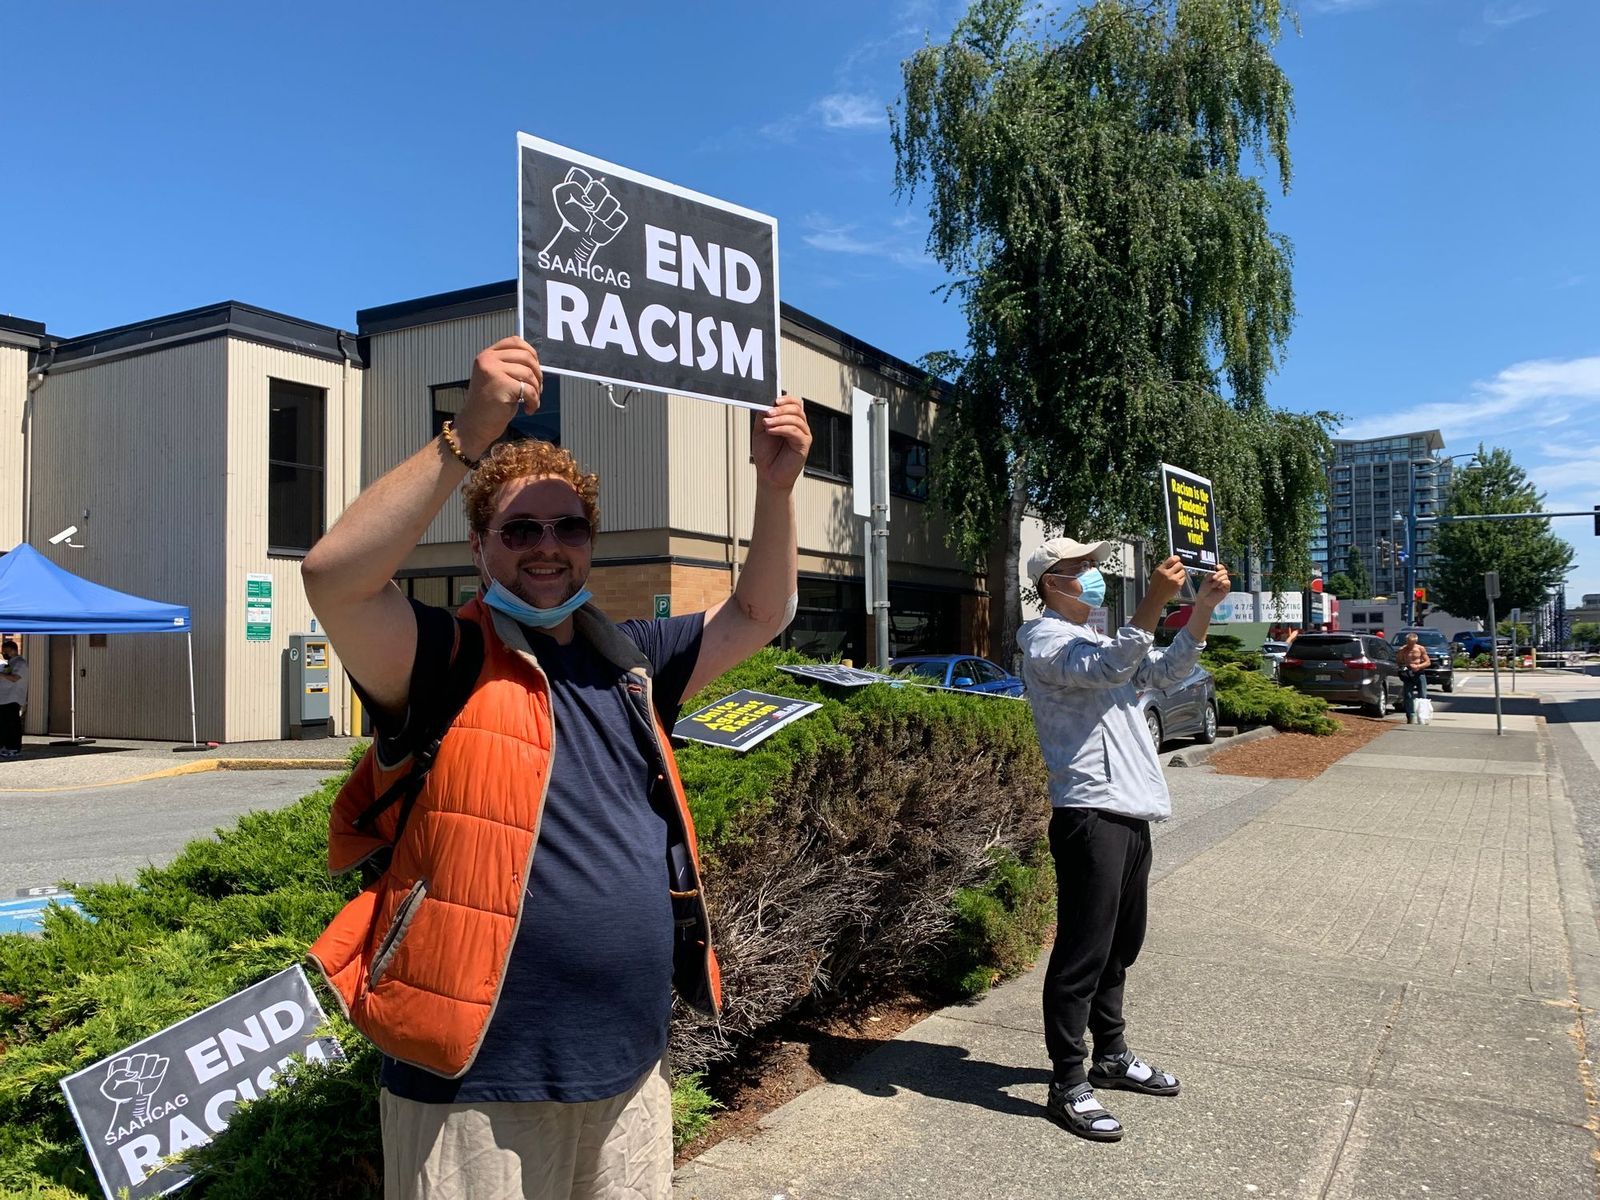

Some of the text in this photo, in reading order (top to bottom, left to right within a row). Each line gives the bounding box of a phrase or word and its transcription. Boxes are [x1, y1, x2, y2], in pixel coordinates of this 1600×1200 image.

[538, 250, 631, 289] SAAHCAG
[645, 223, 762, 304] END
[546, 279, 764, 381] RACISM
[1171, 478, 1209, 503] Racism is the
[1178, 496, 1207, 516] Pandemic!
[1178, 511, 1209, 532] Hate is the
[659, 601, 667, 611] P
[691, 701, 740, 723] Unite
[704, 700, 764, 731] Against
[720, 704, 779, 733] Racism
[185, 999, 305, 1085] END
[1072, 1093, 1093, 1106] PUM
[104, 1093, 189, 1146] SAAHCAG
